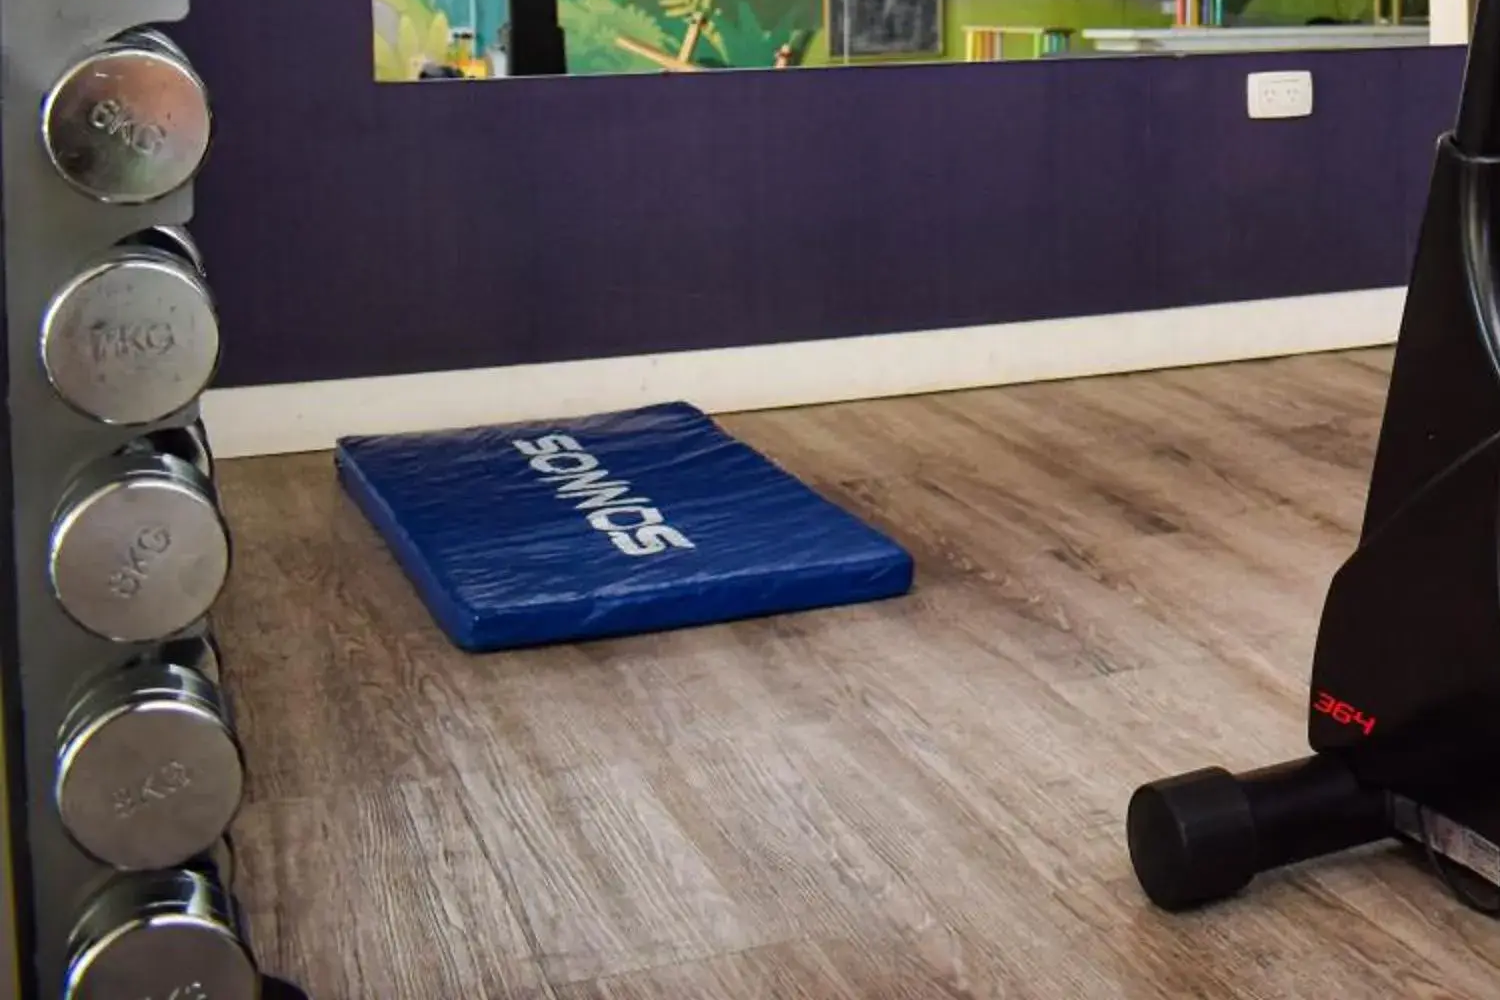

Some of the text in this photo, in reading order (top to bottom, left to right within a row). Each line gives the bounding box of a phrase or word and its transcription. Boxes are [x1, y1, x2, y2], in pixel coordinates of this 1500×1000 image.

[89, 100, 167, 156] 6KG
[108, 526, 171, 598] 8KG
[1313, 692, 1376, 736] 364
